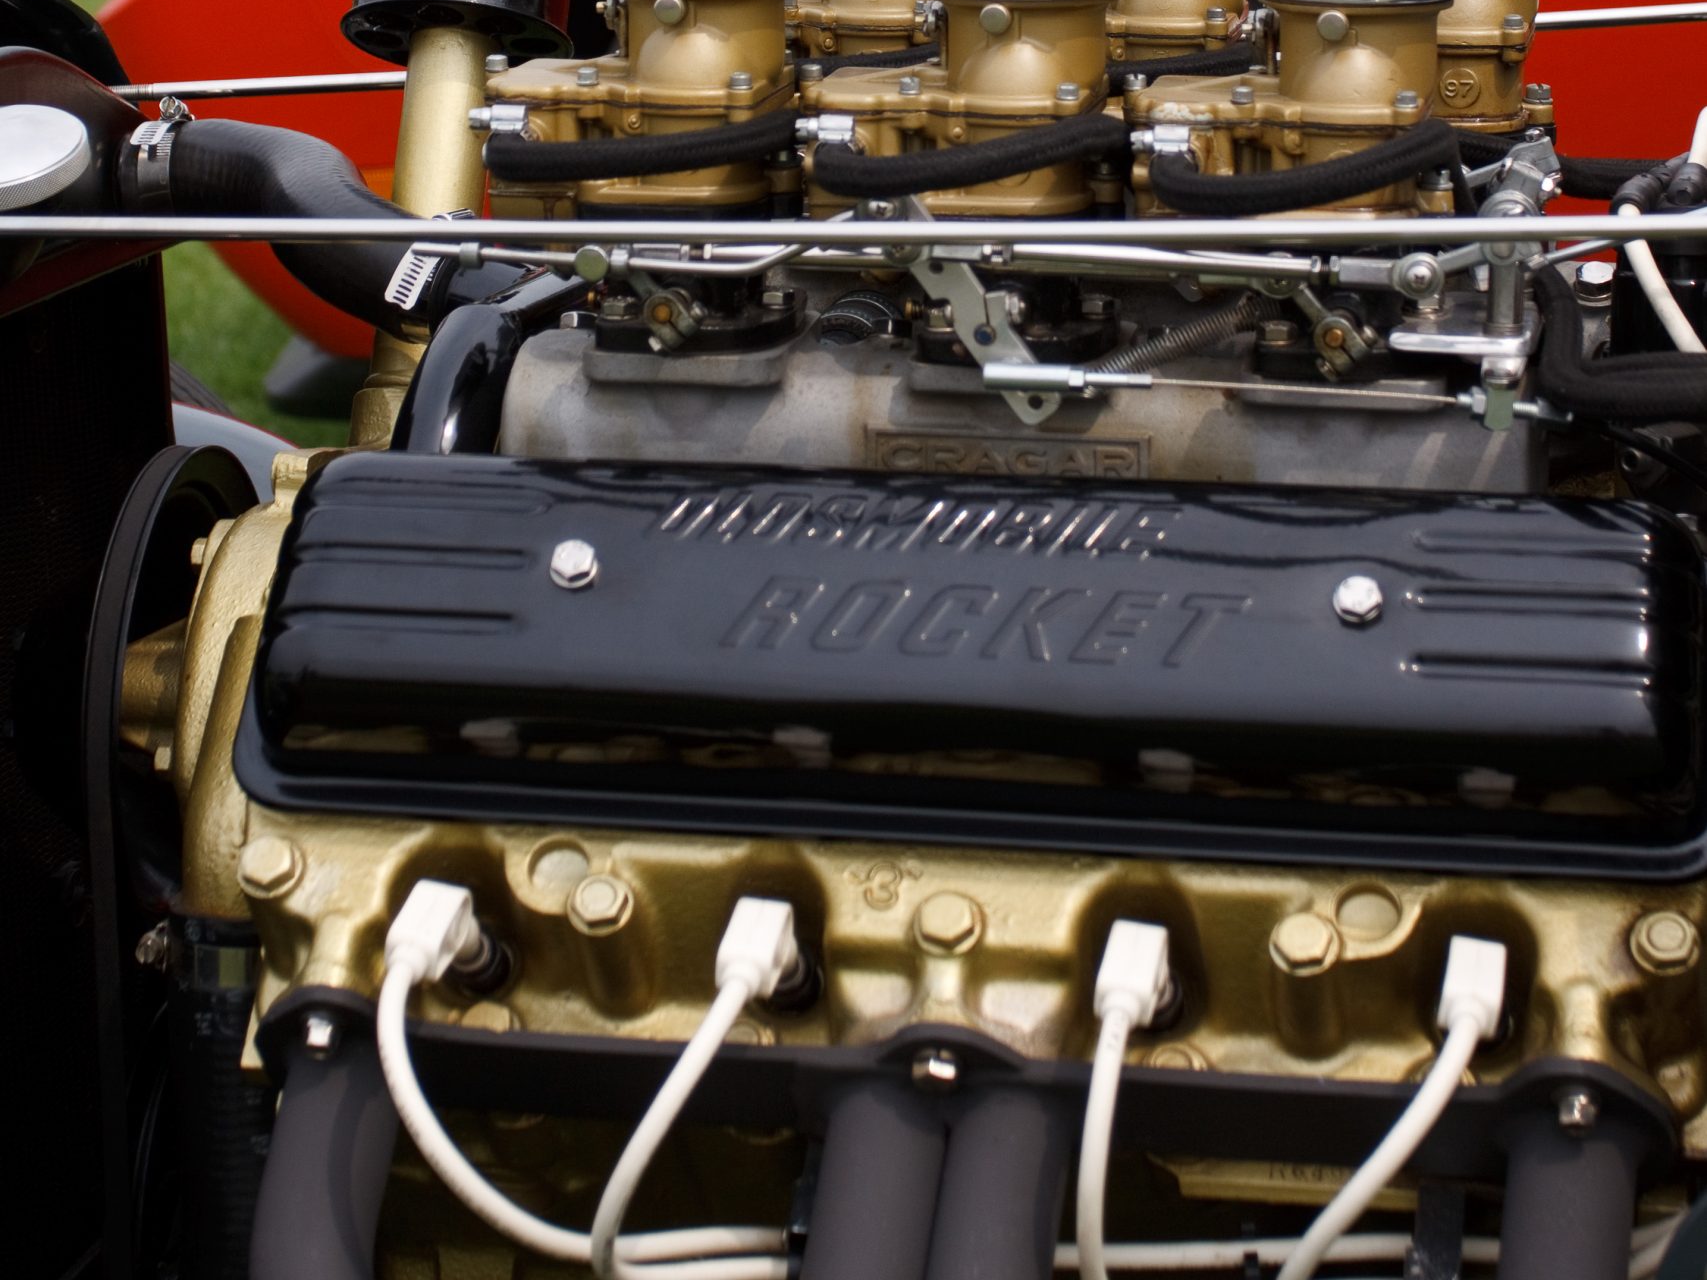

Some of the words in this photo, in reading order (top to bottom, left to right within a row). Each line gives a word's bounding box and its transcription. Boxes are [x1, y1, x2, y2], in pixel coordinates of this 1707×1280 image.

[1445, 79, 1474, 98] 97
[880, 441, 1138, 478] CRAGAR
[718, 575, 1252, 669] ROCKET
